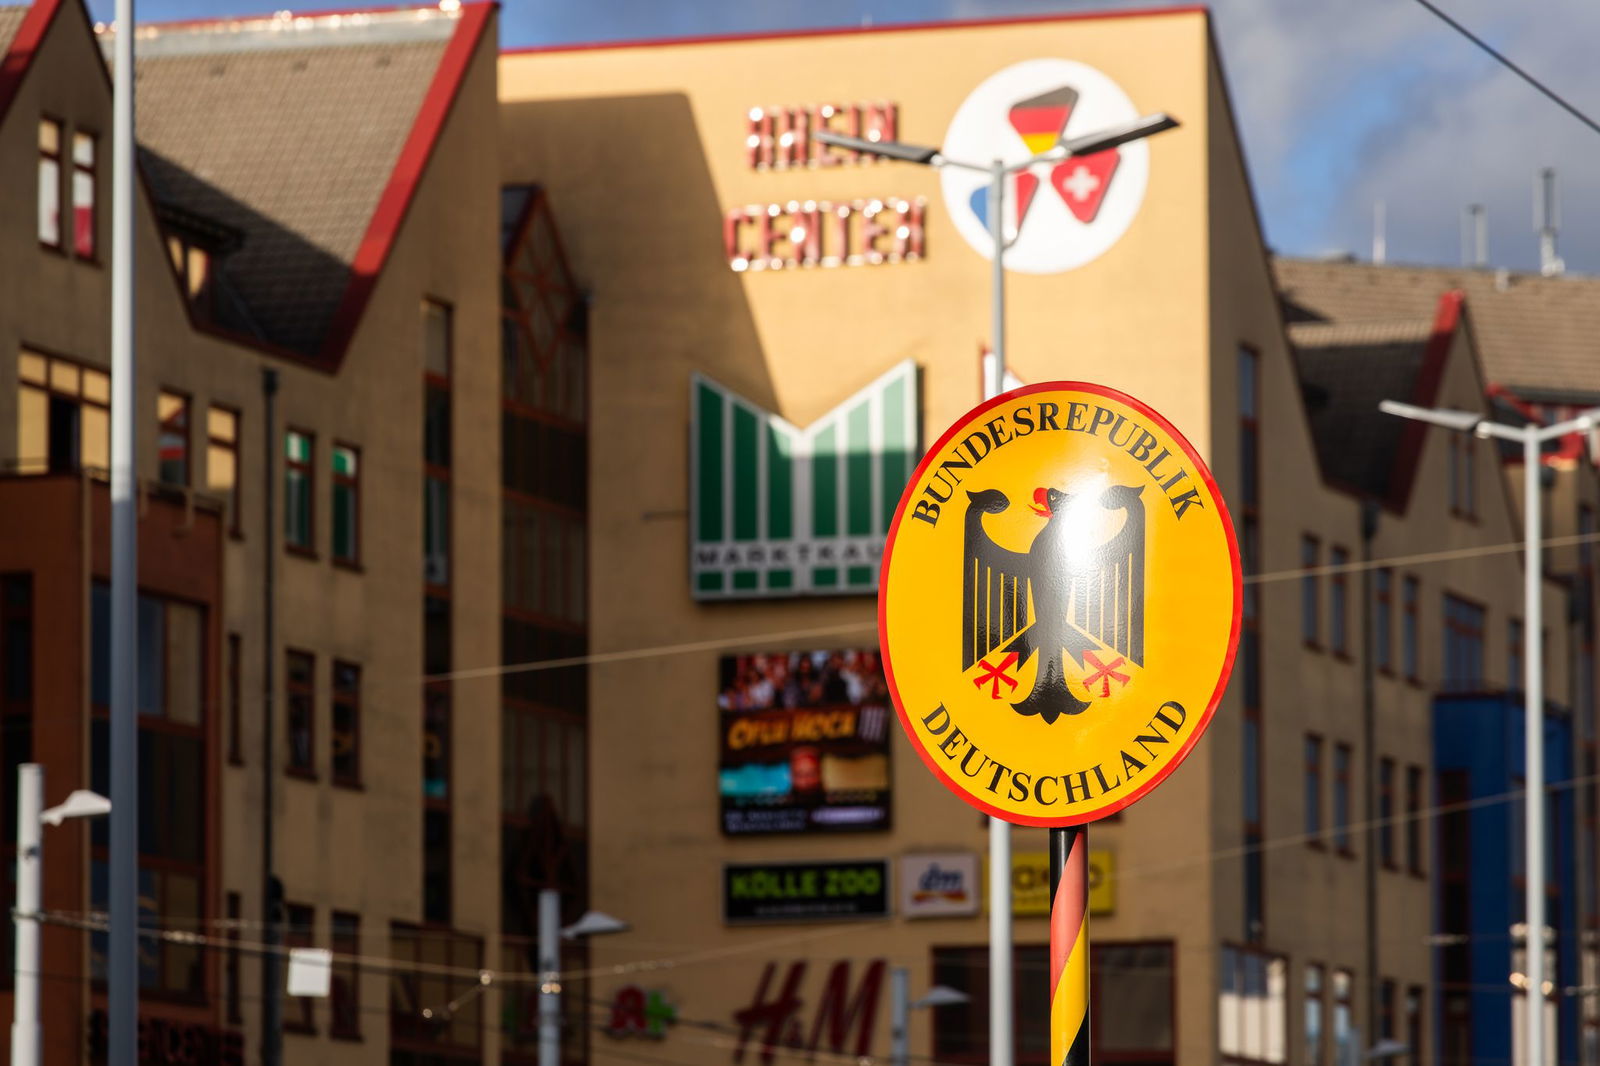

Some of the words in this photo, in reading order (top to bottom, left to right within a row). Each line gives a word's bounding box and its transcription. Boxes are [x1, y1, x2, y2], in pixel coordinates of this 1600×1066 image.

[748, 102, 898, 169] RHEIN
[724, 199, 925, 270] CENTER
[911, 402, 1205, 528] BUNDESREPUBLIK
[696, 544, 885, 566] MARKTKAU
[920, 699, 1187, 806] DEUTSCHLAND
[825, 868, 881, 896] ZOO
[920, 863, 964, 890] dm
[733, 959, 886, 1065] H&M
